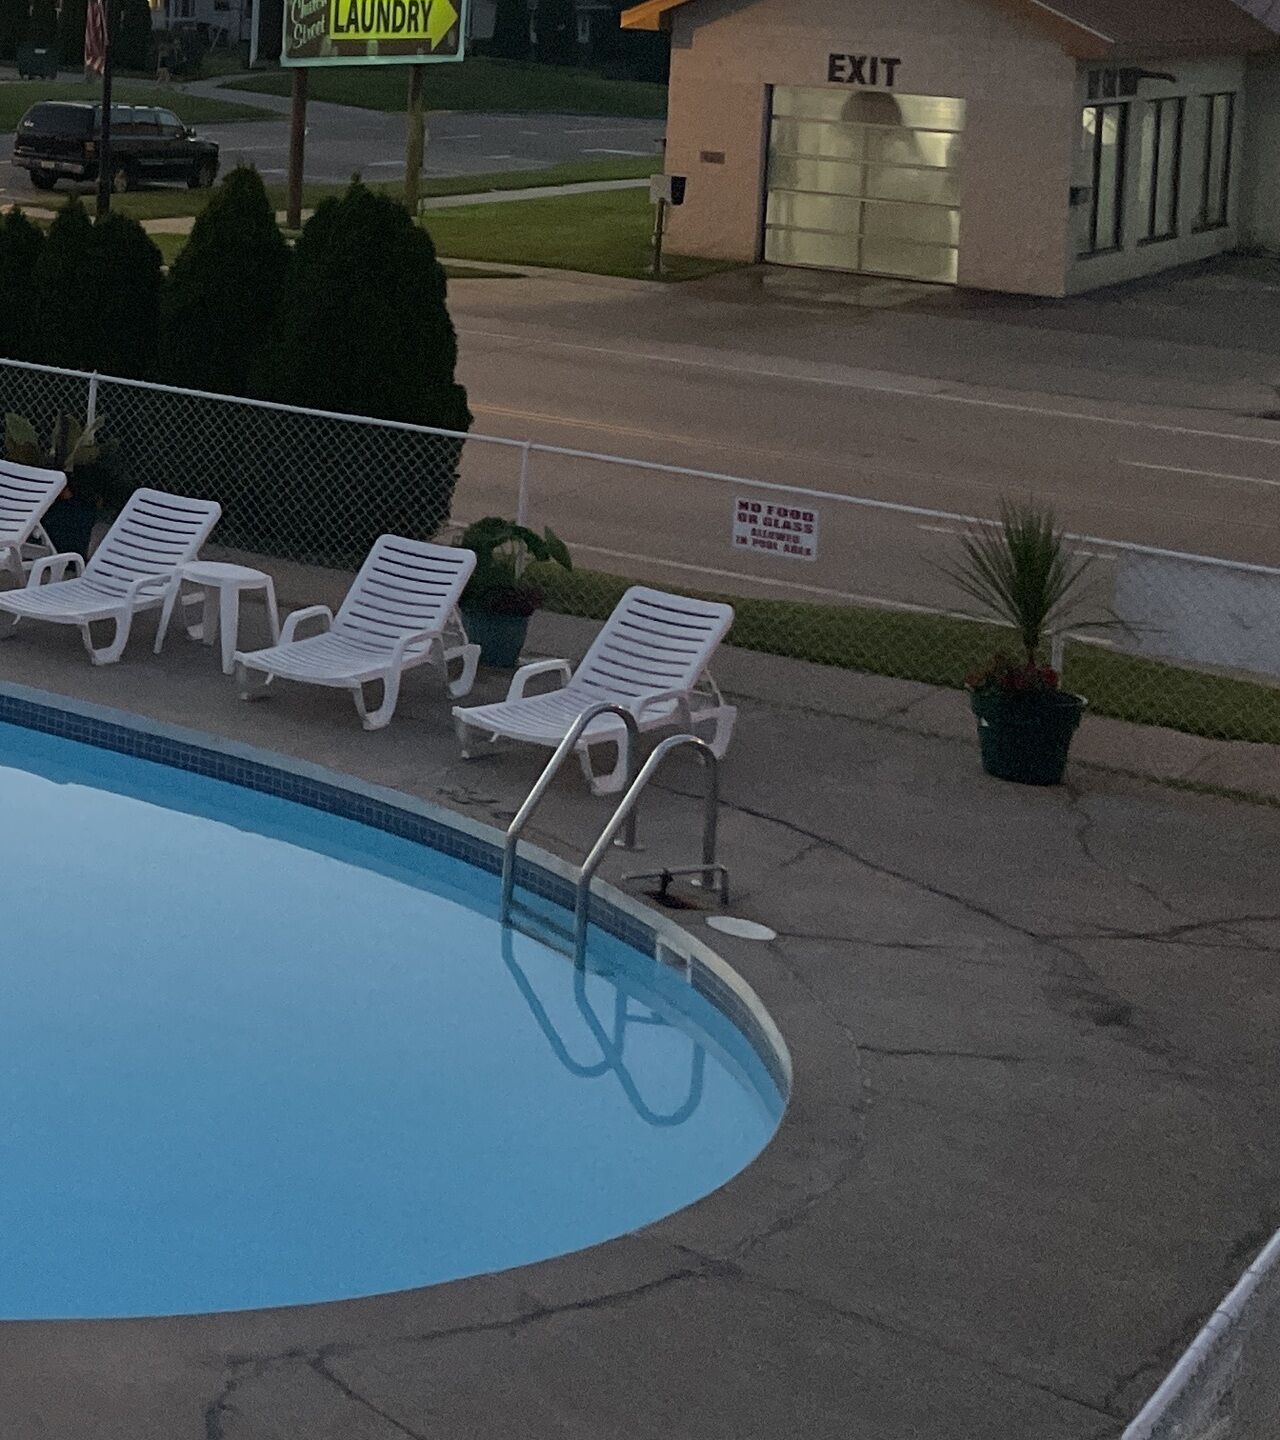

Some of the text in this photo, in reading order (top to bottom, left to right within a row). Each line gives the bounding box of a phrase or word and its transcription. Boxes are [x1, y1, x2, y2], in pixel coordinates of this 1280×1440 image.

[828, 53, 901, 86] EXIT
[738, 501, 814, 522] NO FOOD
[737, 512, 813, 534] OR GLASS
[751, 528, 800, 544] ALLOWED
